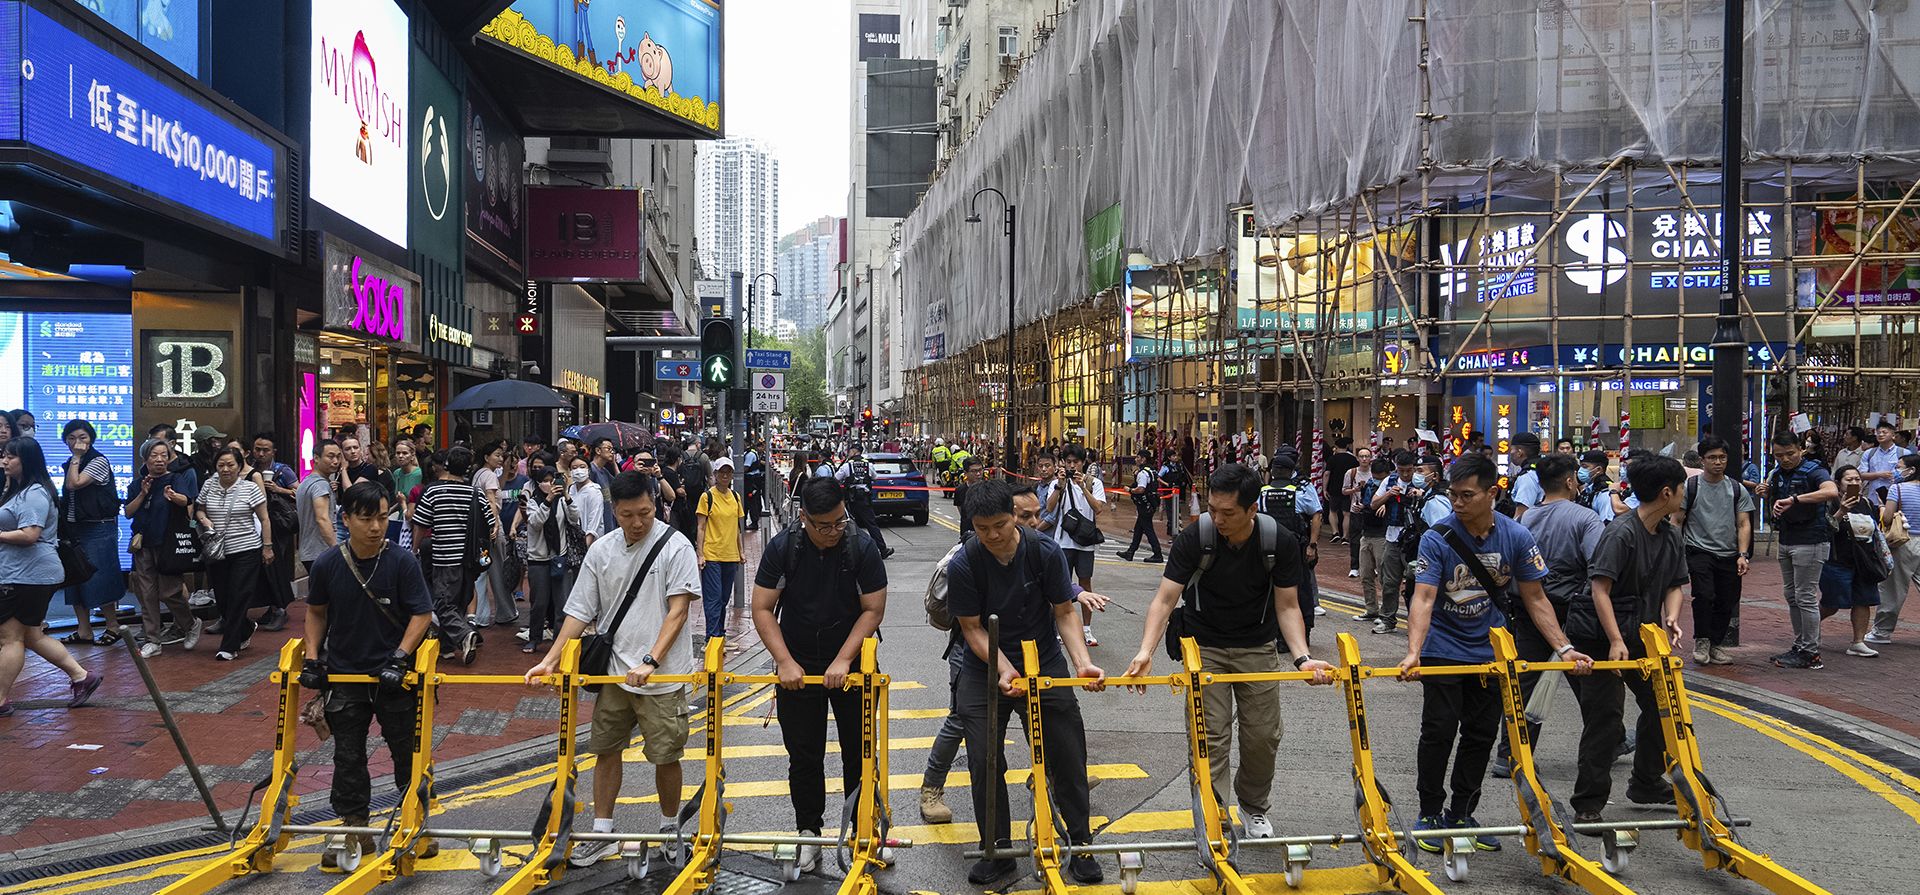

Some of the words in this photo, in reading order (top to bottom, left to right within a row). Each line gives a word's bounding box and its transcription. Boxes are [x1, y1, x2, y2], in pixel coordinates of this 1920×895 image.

[878, 33, 901, 44] MUJI
[320, 36, 351, 104] MY
[358, 69, 401, 148] WISH
[87, 78, 276, 203] 低至HK$10,000開戶
[1651, 210, 1772, 239] 兌換款
[1563, 213, 1628, 294] $
[1650, 237, 1772, 259] CHAE
[1650, 273, 1771, 289] EXCHAGE
[1722, 260, 1730, 292] 50239
[1477, 282, 1535, 303] ECANGE
[1241, 317, 1257, 328] 1/F
[1259, 318, 1273, 328] JP
[438, 322, 448, 341] THE
[448, 326, 461, 345] BODY
[461, 331, 473, 348] SHOP
[1135, 344, 1149, 354] 1/F
[756, 359, 779, 367] 的士站
[1458, 353, 1506, 370] CHANGE
[42, 364, 133, 377] 渣打出糧戶口客
[756, 392, 768, 400] 24
[768, 392, 781, 400] hrs
[757, 401, 779, 411] 全日
[1443, 600, 1483, 615] RACING
